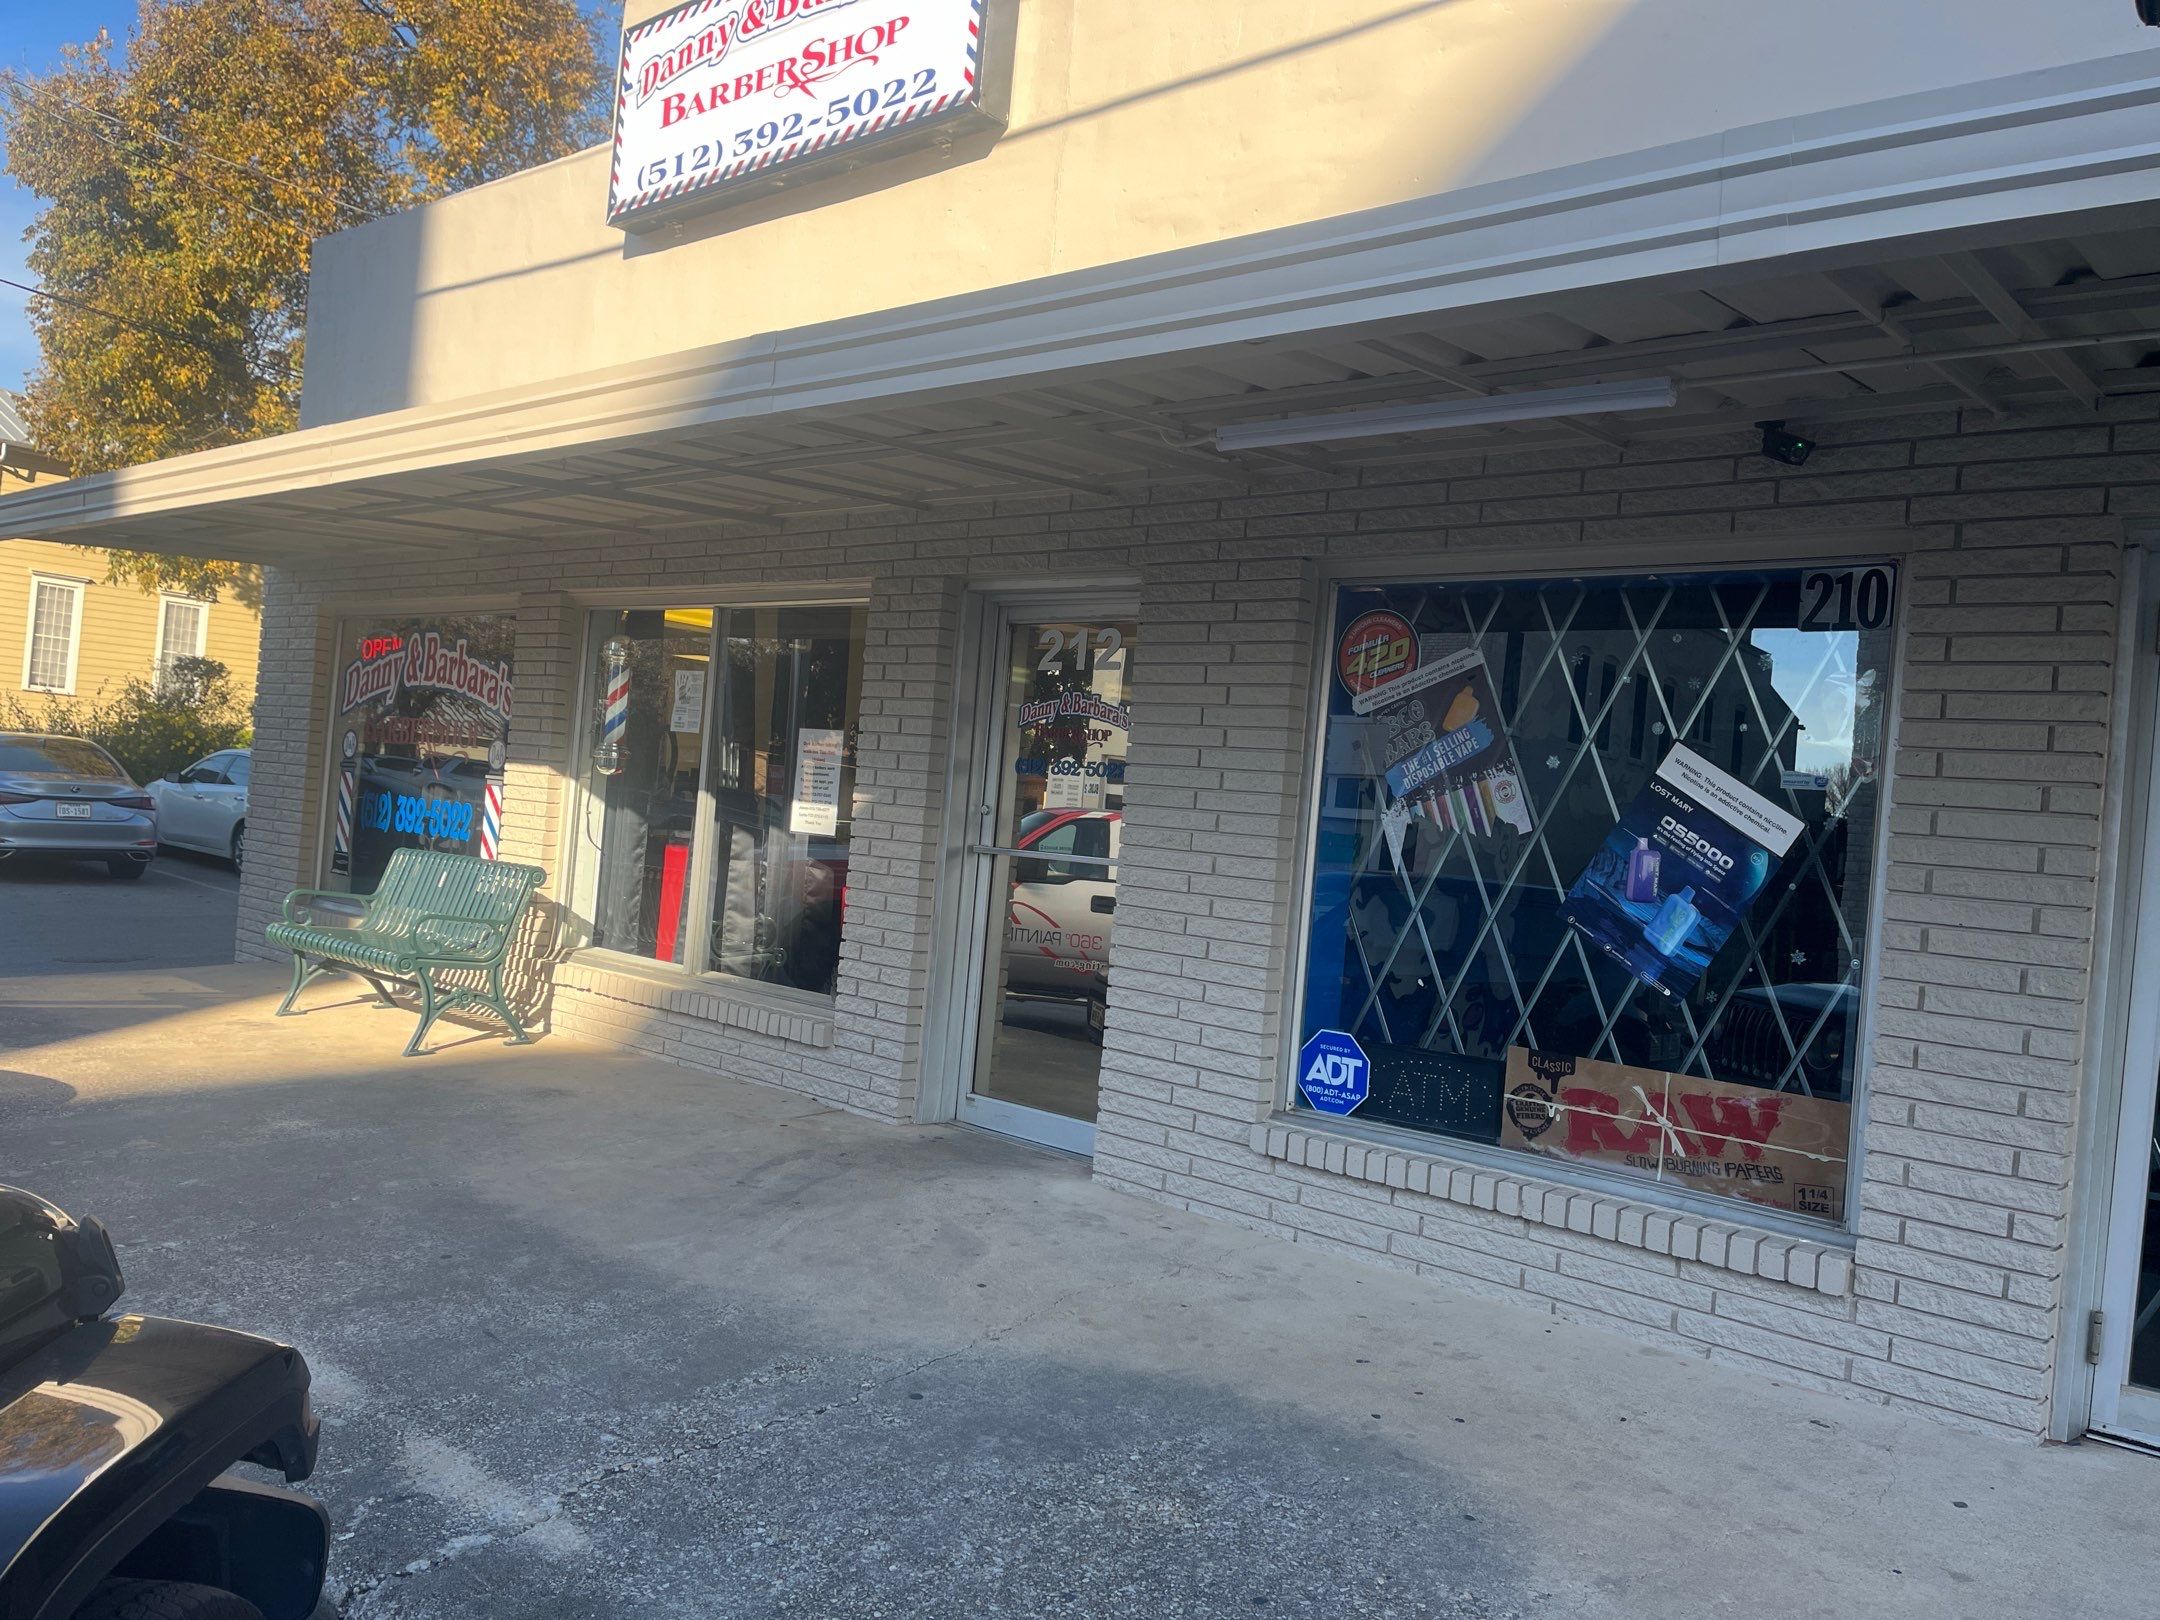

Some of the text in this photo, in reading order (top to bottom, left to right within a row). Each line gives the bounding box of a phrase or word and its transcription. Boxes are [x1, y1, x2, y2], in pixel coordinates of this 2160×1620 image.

[640, 0, 766, 97] Danny &
[637, 68, 938, 191] (512) 392-5022
[1801, 568, 1889, 632] 210
[362, 636, 402, 660] OPEN
[1037, 628, 1122, 671] 212
[1345, 636, 1411, 676] 420
[1347, 634, 1390, 656] FORMULA
[342, 633, 513, 719] Danny & Barbara's
[1369, 661, 1405, 679] CLEANERS
[1388, 684, 1401, 693] This
[1401, 674, 1424, 688] product
[1425, 663, 1450, 677] contains
[1371, 693, 1396, 706] Nicotine
[1402, 687, 1411, 695] an
[1411, 676, 1438, 691] addictive
[1019, 692, 1130, 730] Danny & Barbara's
[1402, 728, 1471, 776] THE #1 SELLING
[1402, 737, 1480, 790] DISPOSABLE VAPE
[1650, 781, 1694, 814] LOST MARY
[1681, 771, 1704, 791] Nicotine
[1703, 786, 1710, 795] is
[1710, 791, 1719, 799] an
[1718, 795, 1744, 816] addictive
[1704, 777, 1716, 789] This
[1715, 785, 1739, 803] product
[1738, 800, 1764, 820] contains
[361, 790, 474, 842] (512) 392-5022
[1660, 815, 1734, 870] OS5000
[1320, 1043, 1343, 1053] SECURED
[1531, 1055, 1572, 1073] CLASSIC
[1305, 1053, 1363, 1090] ADT
[1305, 1084, 1361, 1101] (800) ADT-ASAP
[1320, 1096, 1345, 1105] ADT.COM
[1388, 1069, 1471, 1115] ATM
[1516, 1112, 1546, 1120] FIBERS
[1560, 1086, 1793, 1160] RAW
[1724, 1162, 1784, 1180] PAPERS
[1798, 1187, 1806, 1200] 1
[1809, 1189, 1829, 1200] 1/4
[1798, 1200, 1830, 1213] SIZE
